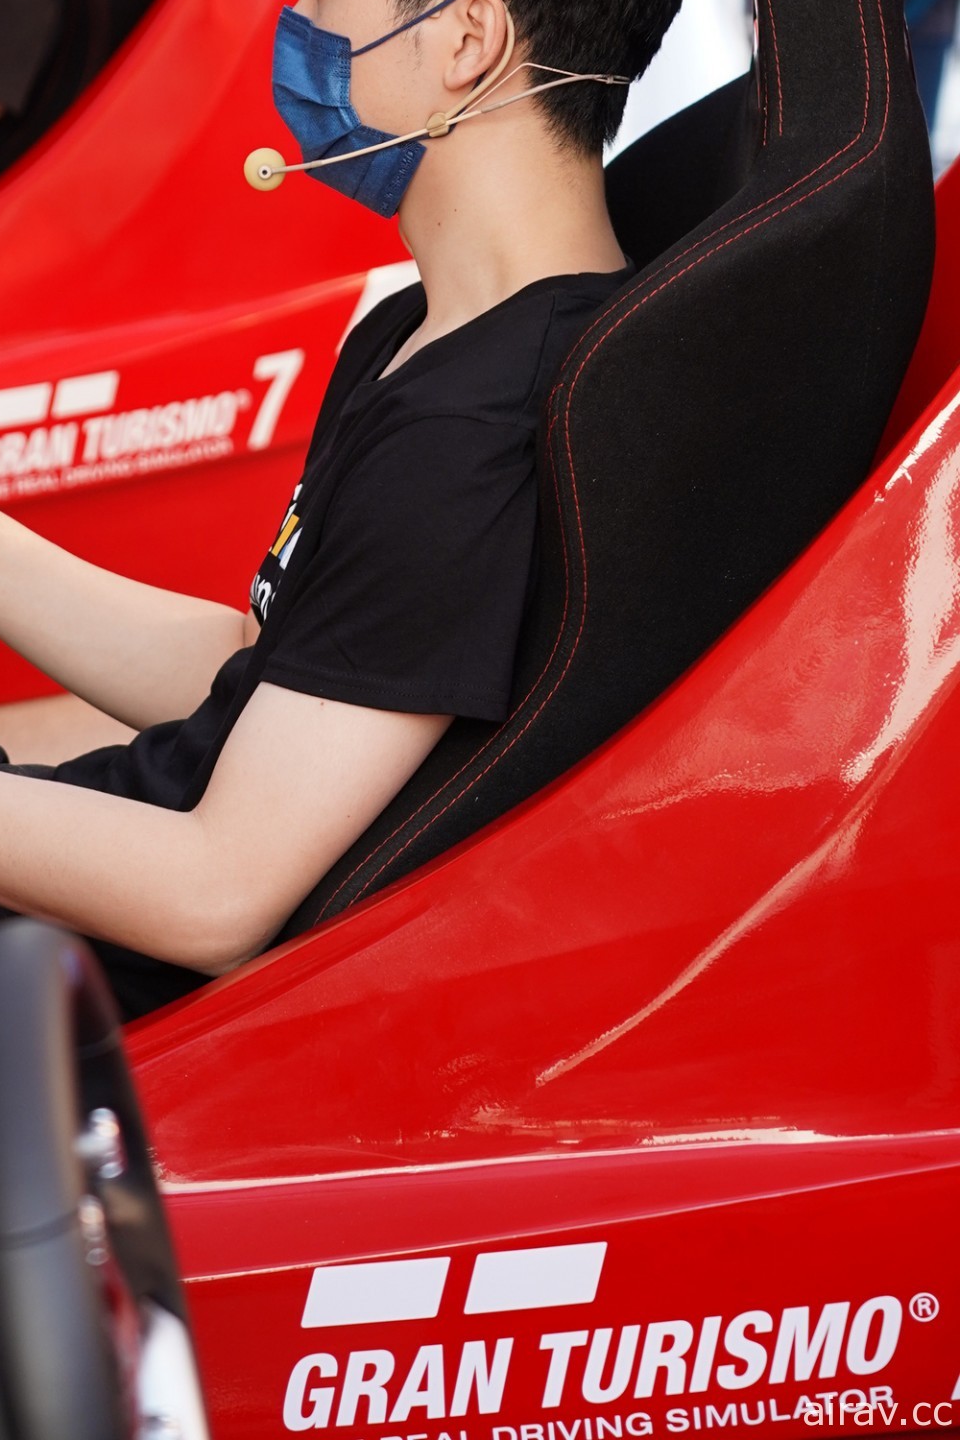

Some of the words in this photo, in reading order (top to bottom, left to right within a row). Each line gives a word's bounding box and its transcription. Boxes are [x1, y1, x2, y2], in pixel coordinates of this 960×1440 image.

[81, 389, 240, 463] TURISMO
[247, 348, 306, 452] 7
[282, 1336, 514, 1432] GRAN
[666, 1385, 894, 1433] SIMULATOR
